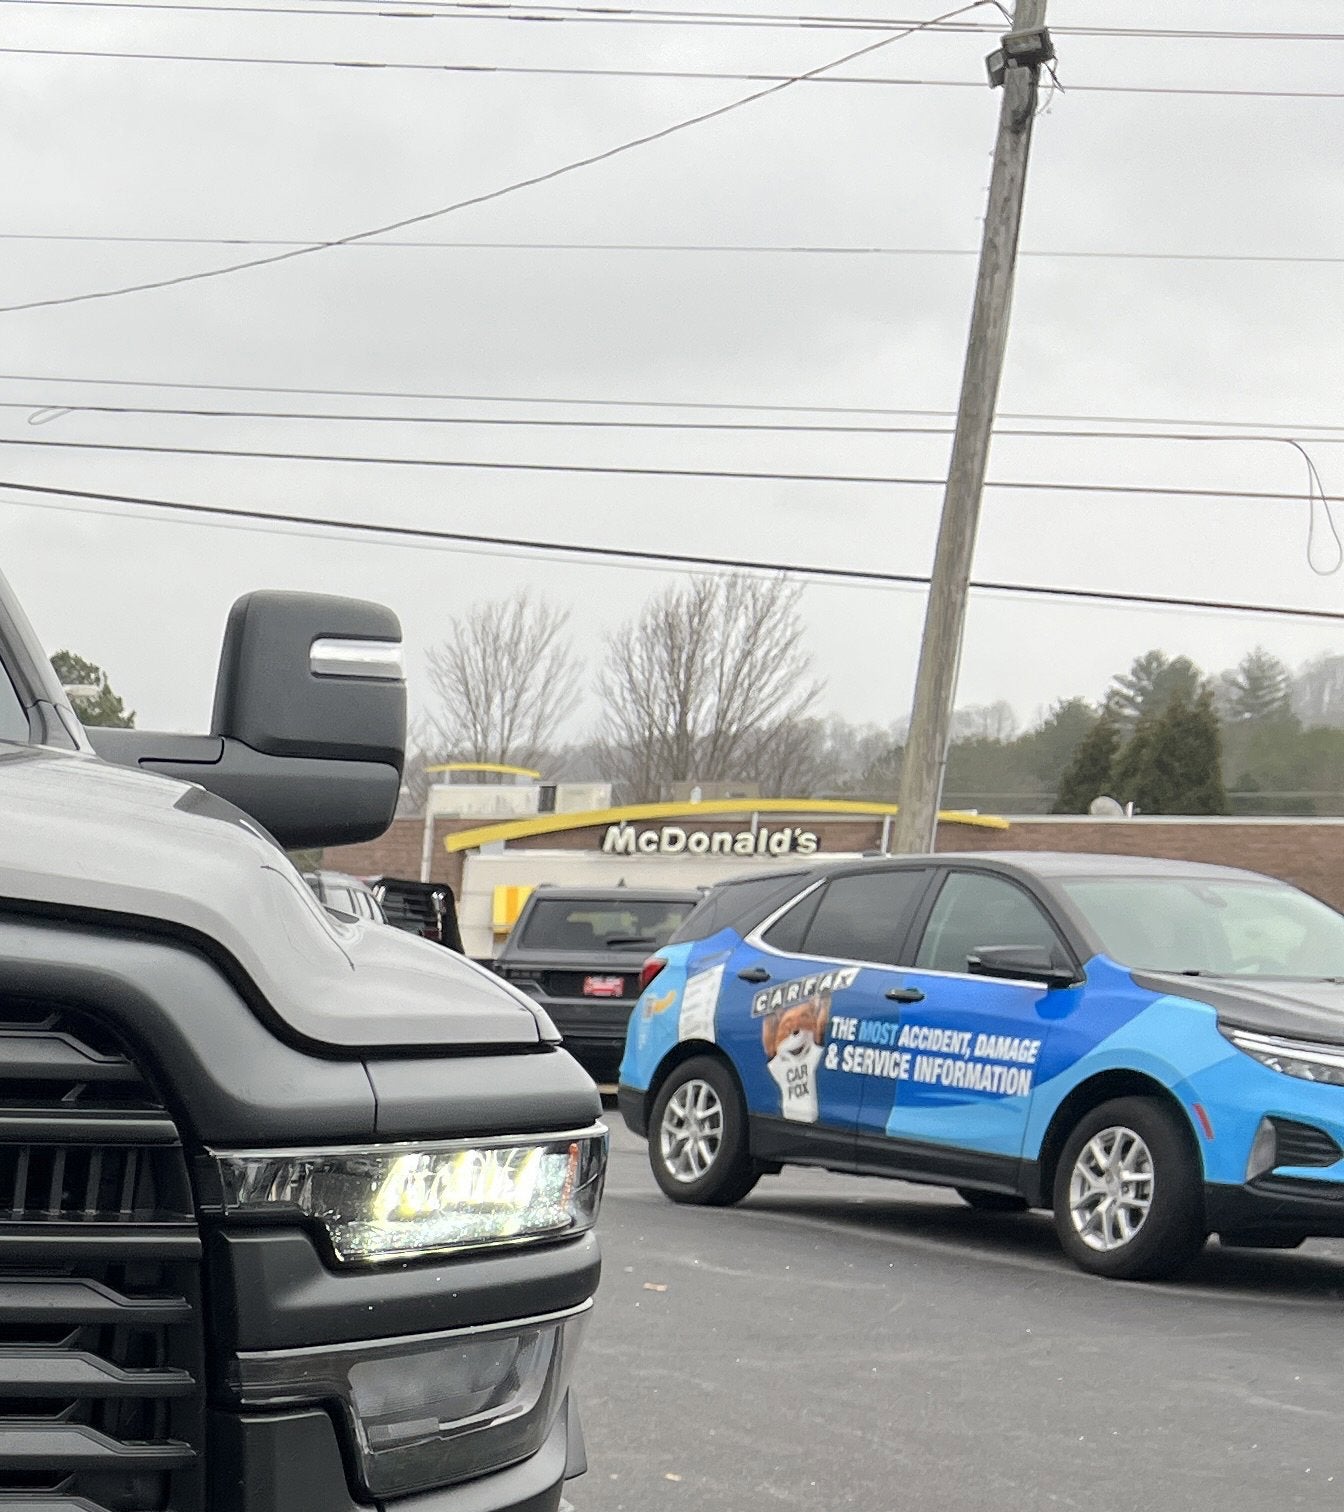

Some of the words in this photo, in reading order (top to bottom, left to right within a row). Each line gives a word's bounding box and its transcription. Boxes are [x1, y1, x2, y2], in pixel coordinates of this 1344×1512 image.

[602, 824, 819, 856] McDonald's
[755, 968, 861, 1012] CARFAX
[831, 1015, 858, 1042] THE
[858, 1019, 899, 1047] MOST
[898, 1024, 972, 1060] ACCIDENT,
[974, 1033, 1042, 1065] DAMAGE
[786, 1064, 809, 1083] CAR
[825, 1043, 839, 1070] &
[842, 1044, 912, 1081] SERVICE
[914, 1054, 1033, 1097] INFORMATION
[788, 1082, 810, 1100] FOX
